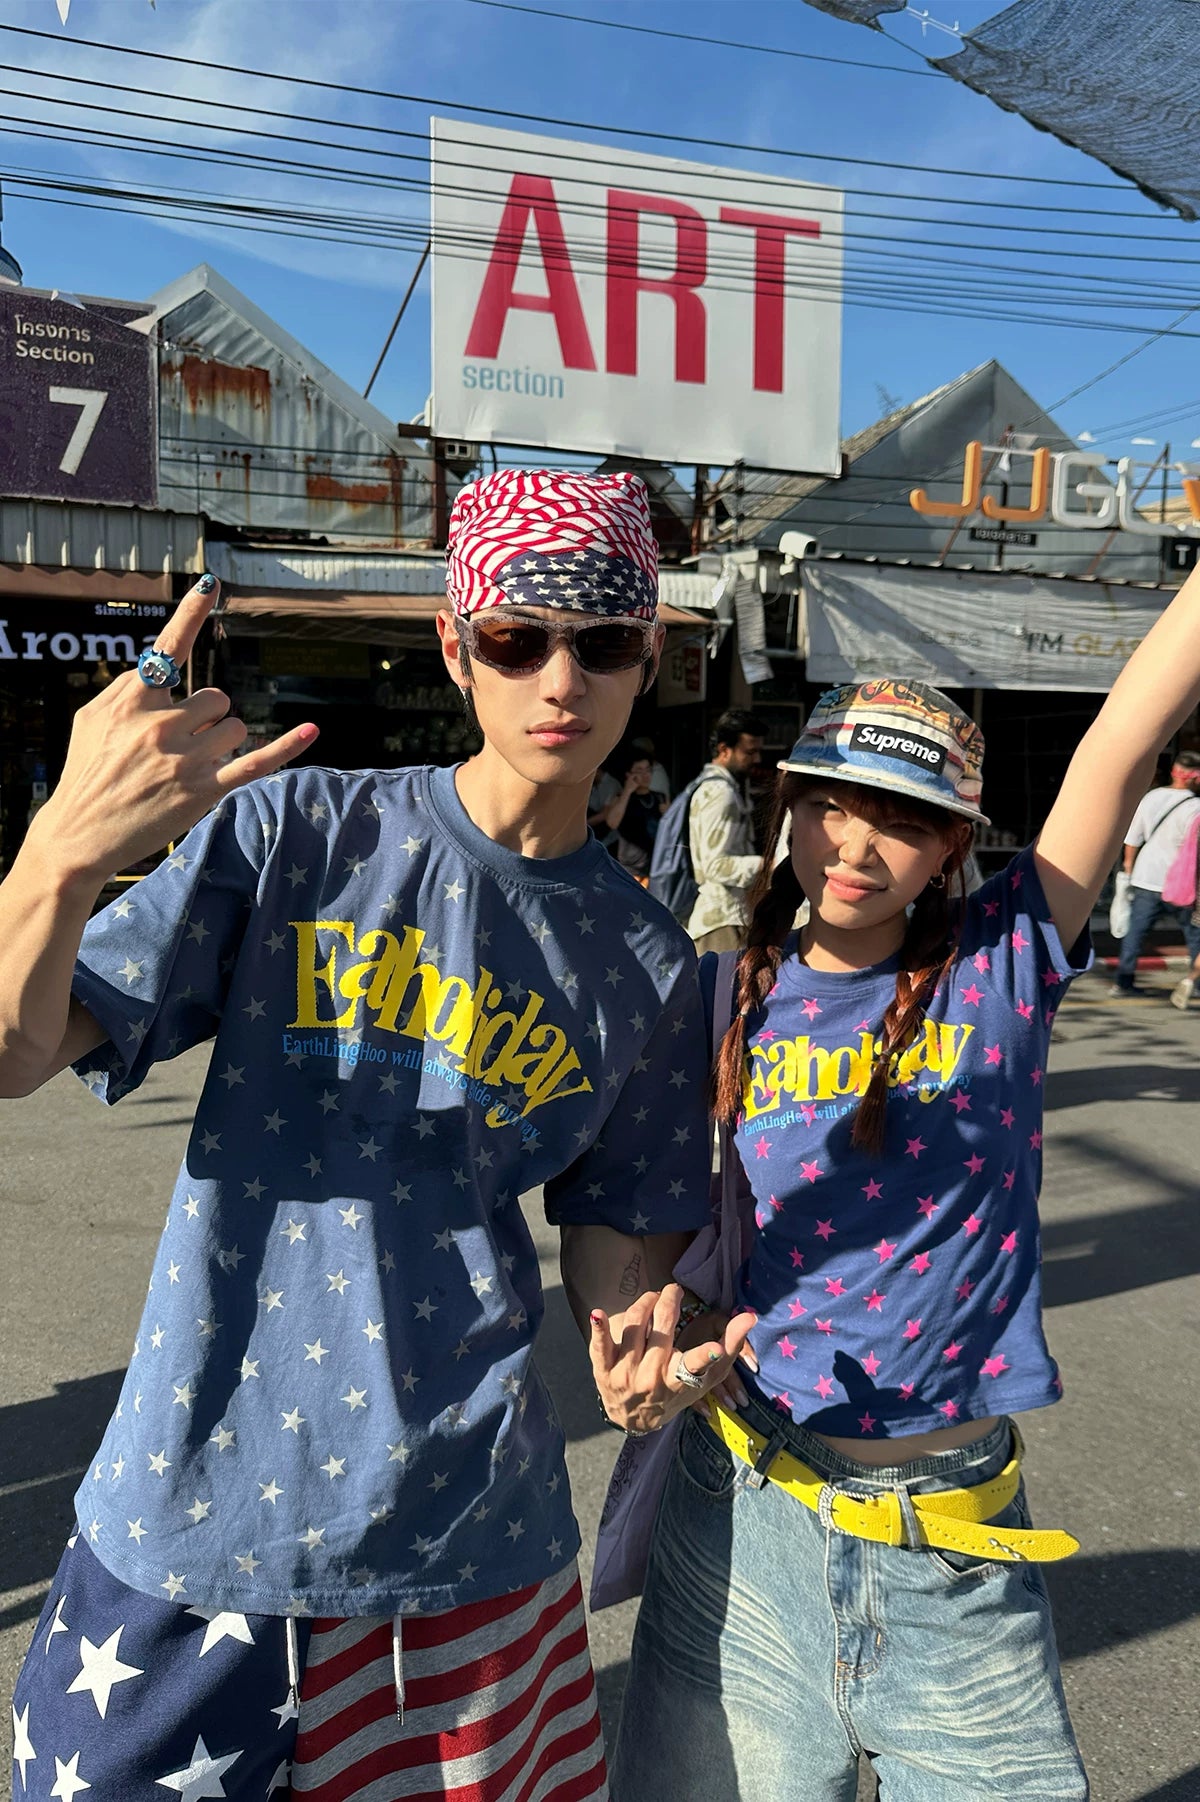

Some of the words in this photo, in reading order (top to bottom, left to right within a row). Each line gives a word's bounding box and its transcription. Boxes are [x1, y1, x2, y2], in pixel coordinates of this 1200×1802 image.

[464, 172, 821, 393] ART
[14, 313, 91, 342] โครงการ
[16, 339, 95, 365] Section
[462, 364, 565, 399] section
[49, 386, 108, 476] 7
[0, 620, 160, 662] Arom
[857, 727, 940, 764] Supreme
[286, 921, 593, 1128] Eaholiday
[282, 1033, 387, 1066] EarthLingHoo
[392, 1048, 422, 1070] will
[424, 1057, 468, 1090] always
[742, 1018, 975, 1121] Eaholday
[815, 1104, 838, 1120] will
